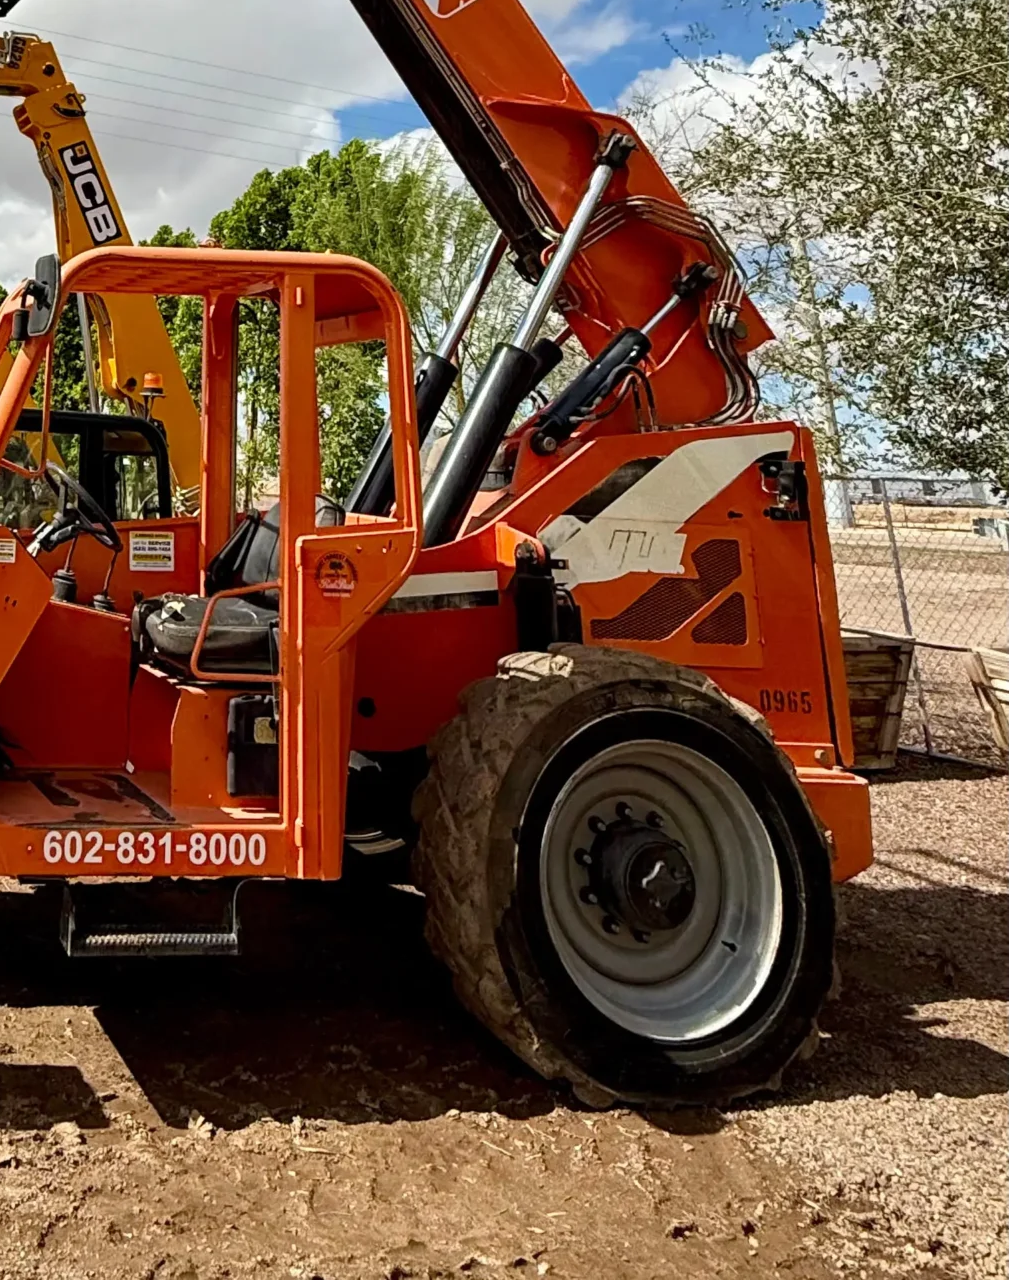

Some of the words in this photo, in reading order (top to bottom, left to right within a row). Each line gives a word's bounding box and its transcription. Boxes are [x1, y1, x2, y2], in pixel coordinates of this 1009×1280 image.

[63, 148, 117, 242] JCB
[760, 689, 812, 714] 0965
[43, 831, 266, 865] 602-831-8000
